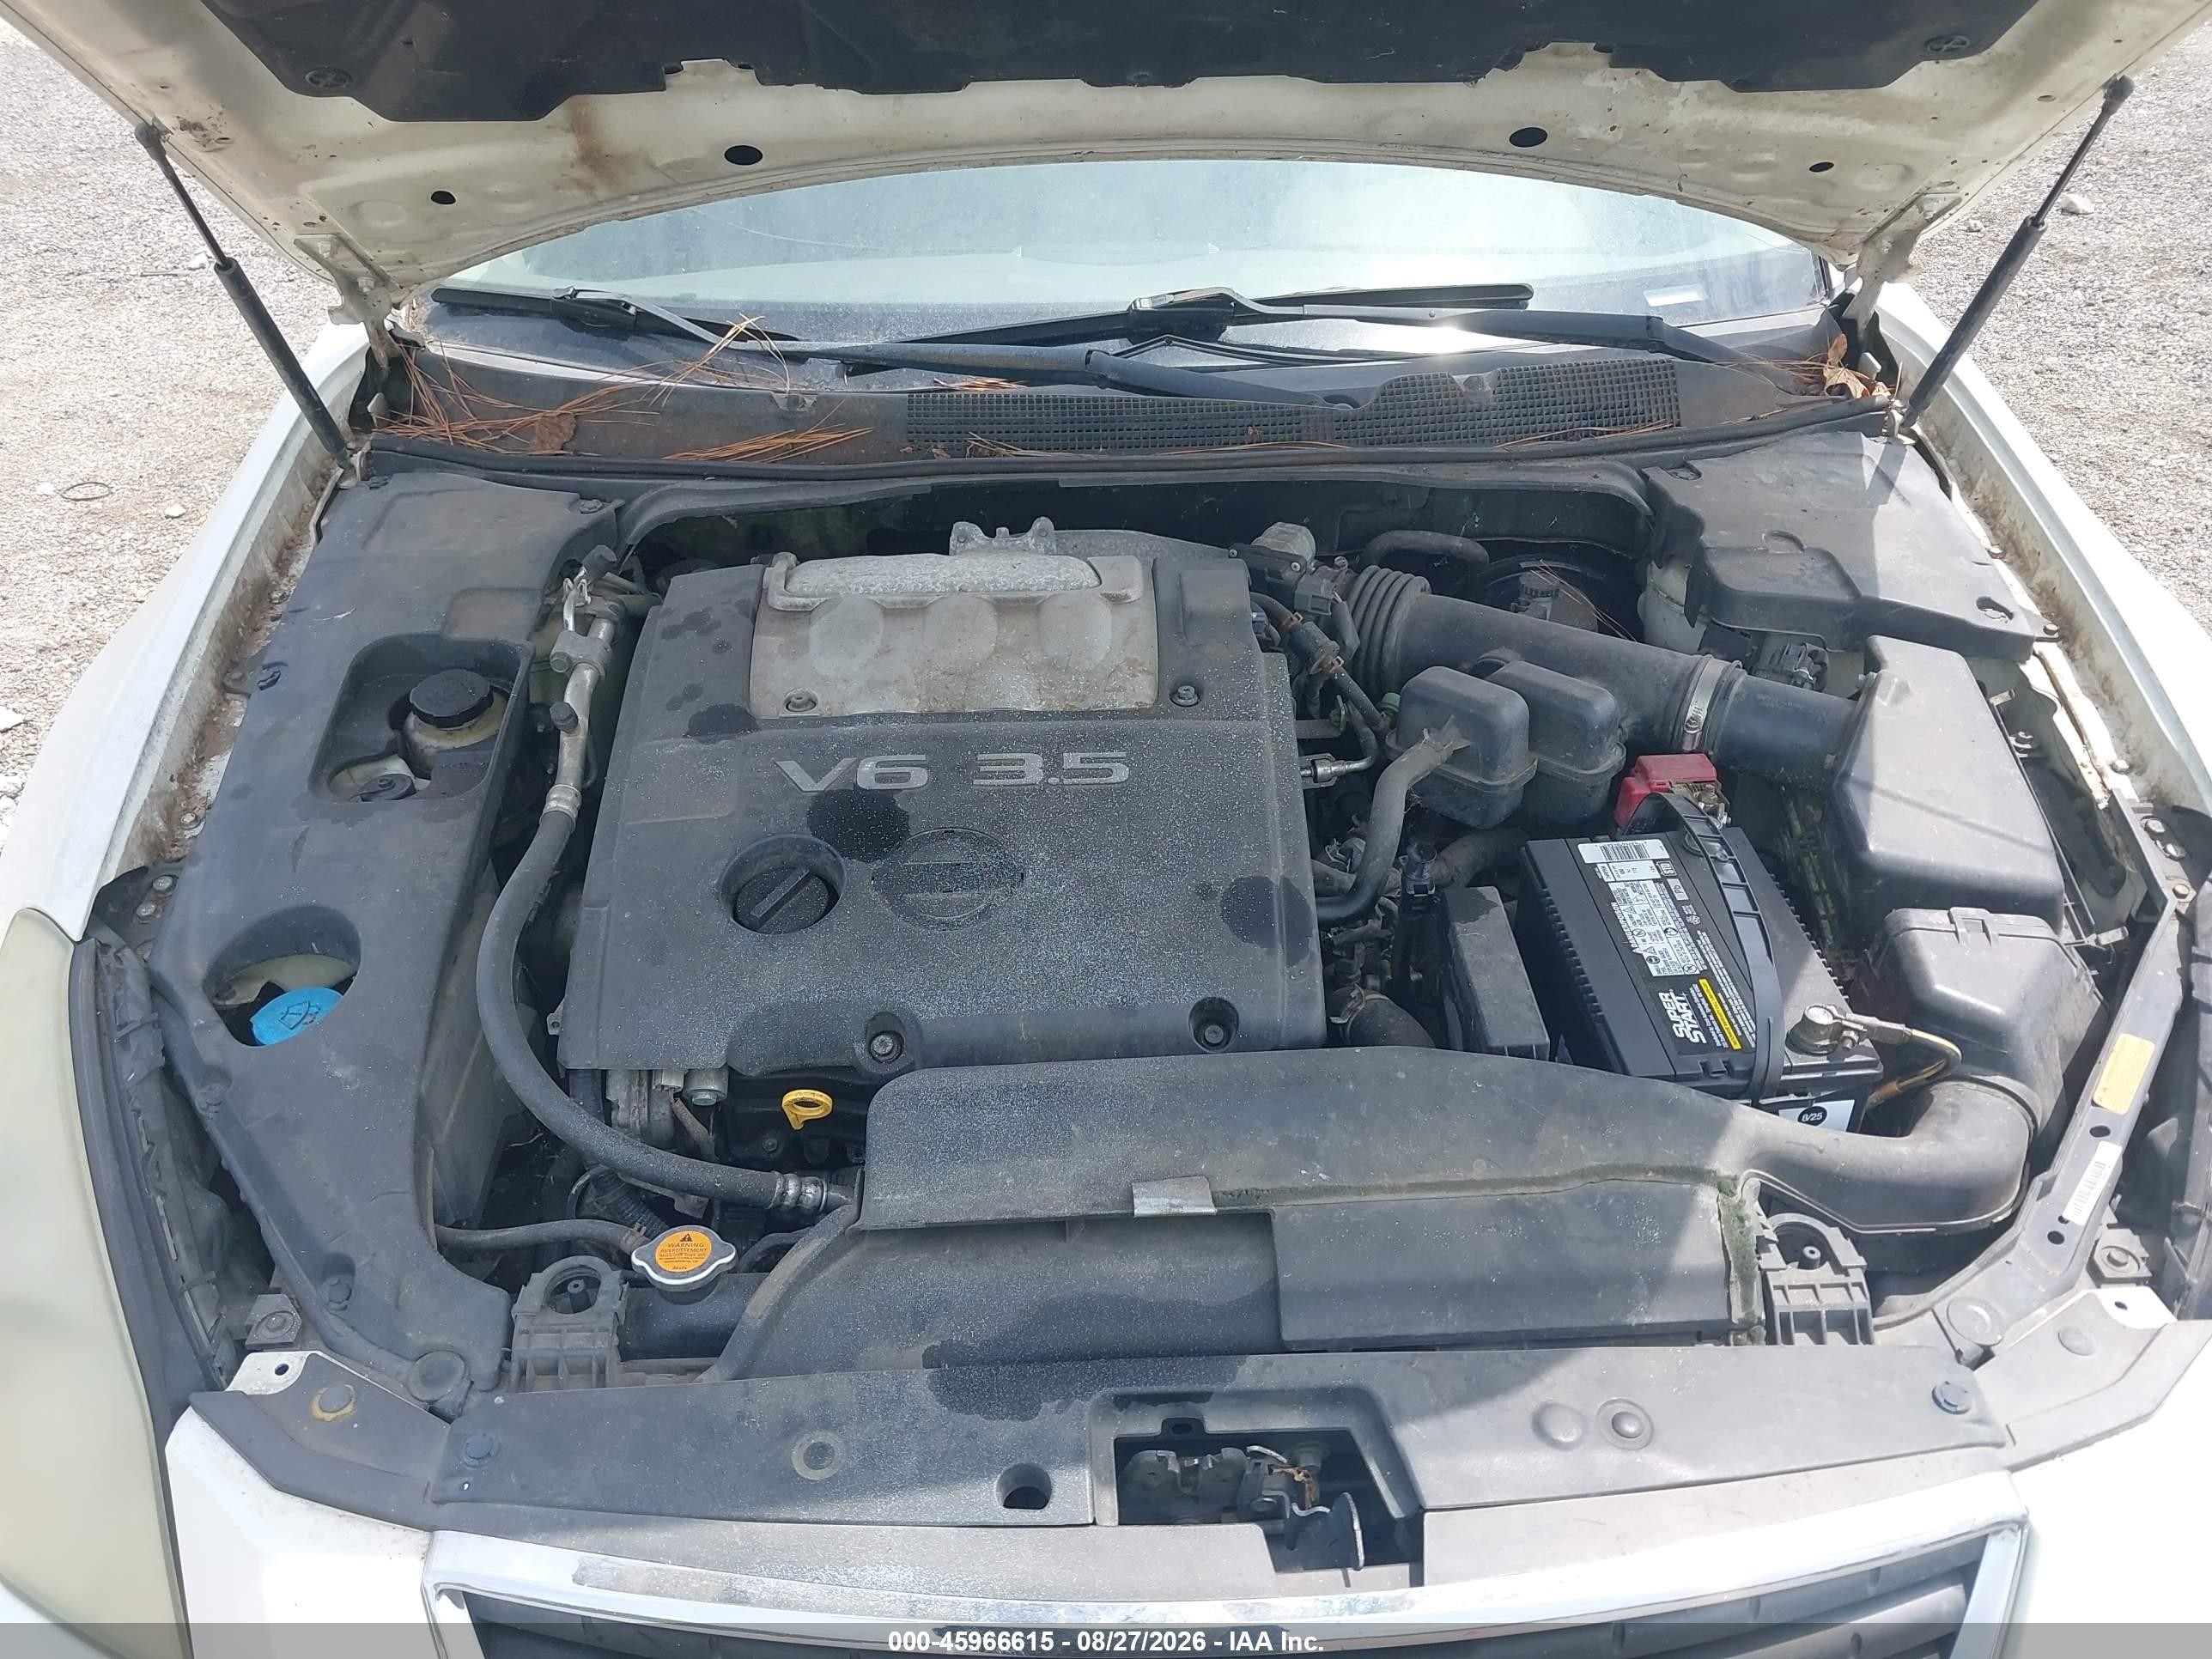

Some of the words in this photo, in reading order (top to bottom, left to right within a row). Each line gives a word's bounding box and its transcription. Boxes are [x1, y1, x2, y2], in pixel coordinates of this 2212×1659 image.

[774, 753, 929, 793] V6
[972, 750, 1131, 787] 3.5
[1673, 884, 1684, 894] Pb
[1658, 992, 1686, 1039] SUPER
[1668, 992, 1706, 1044] START
[1802, 1112, 1823, 1122] 8/25
